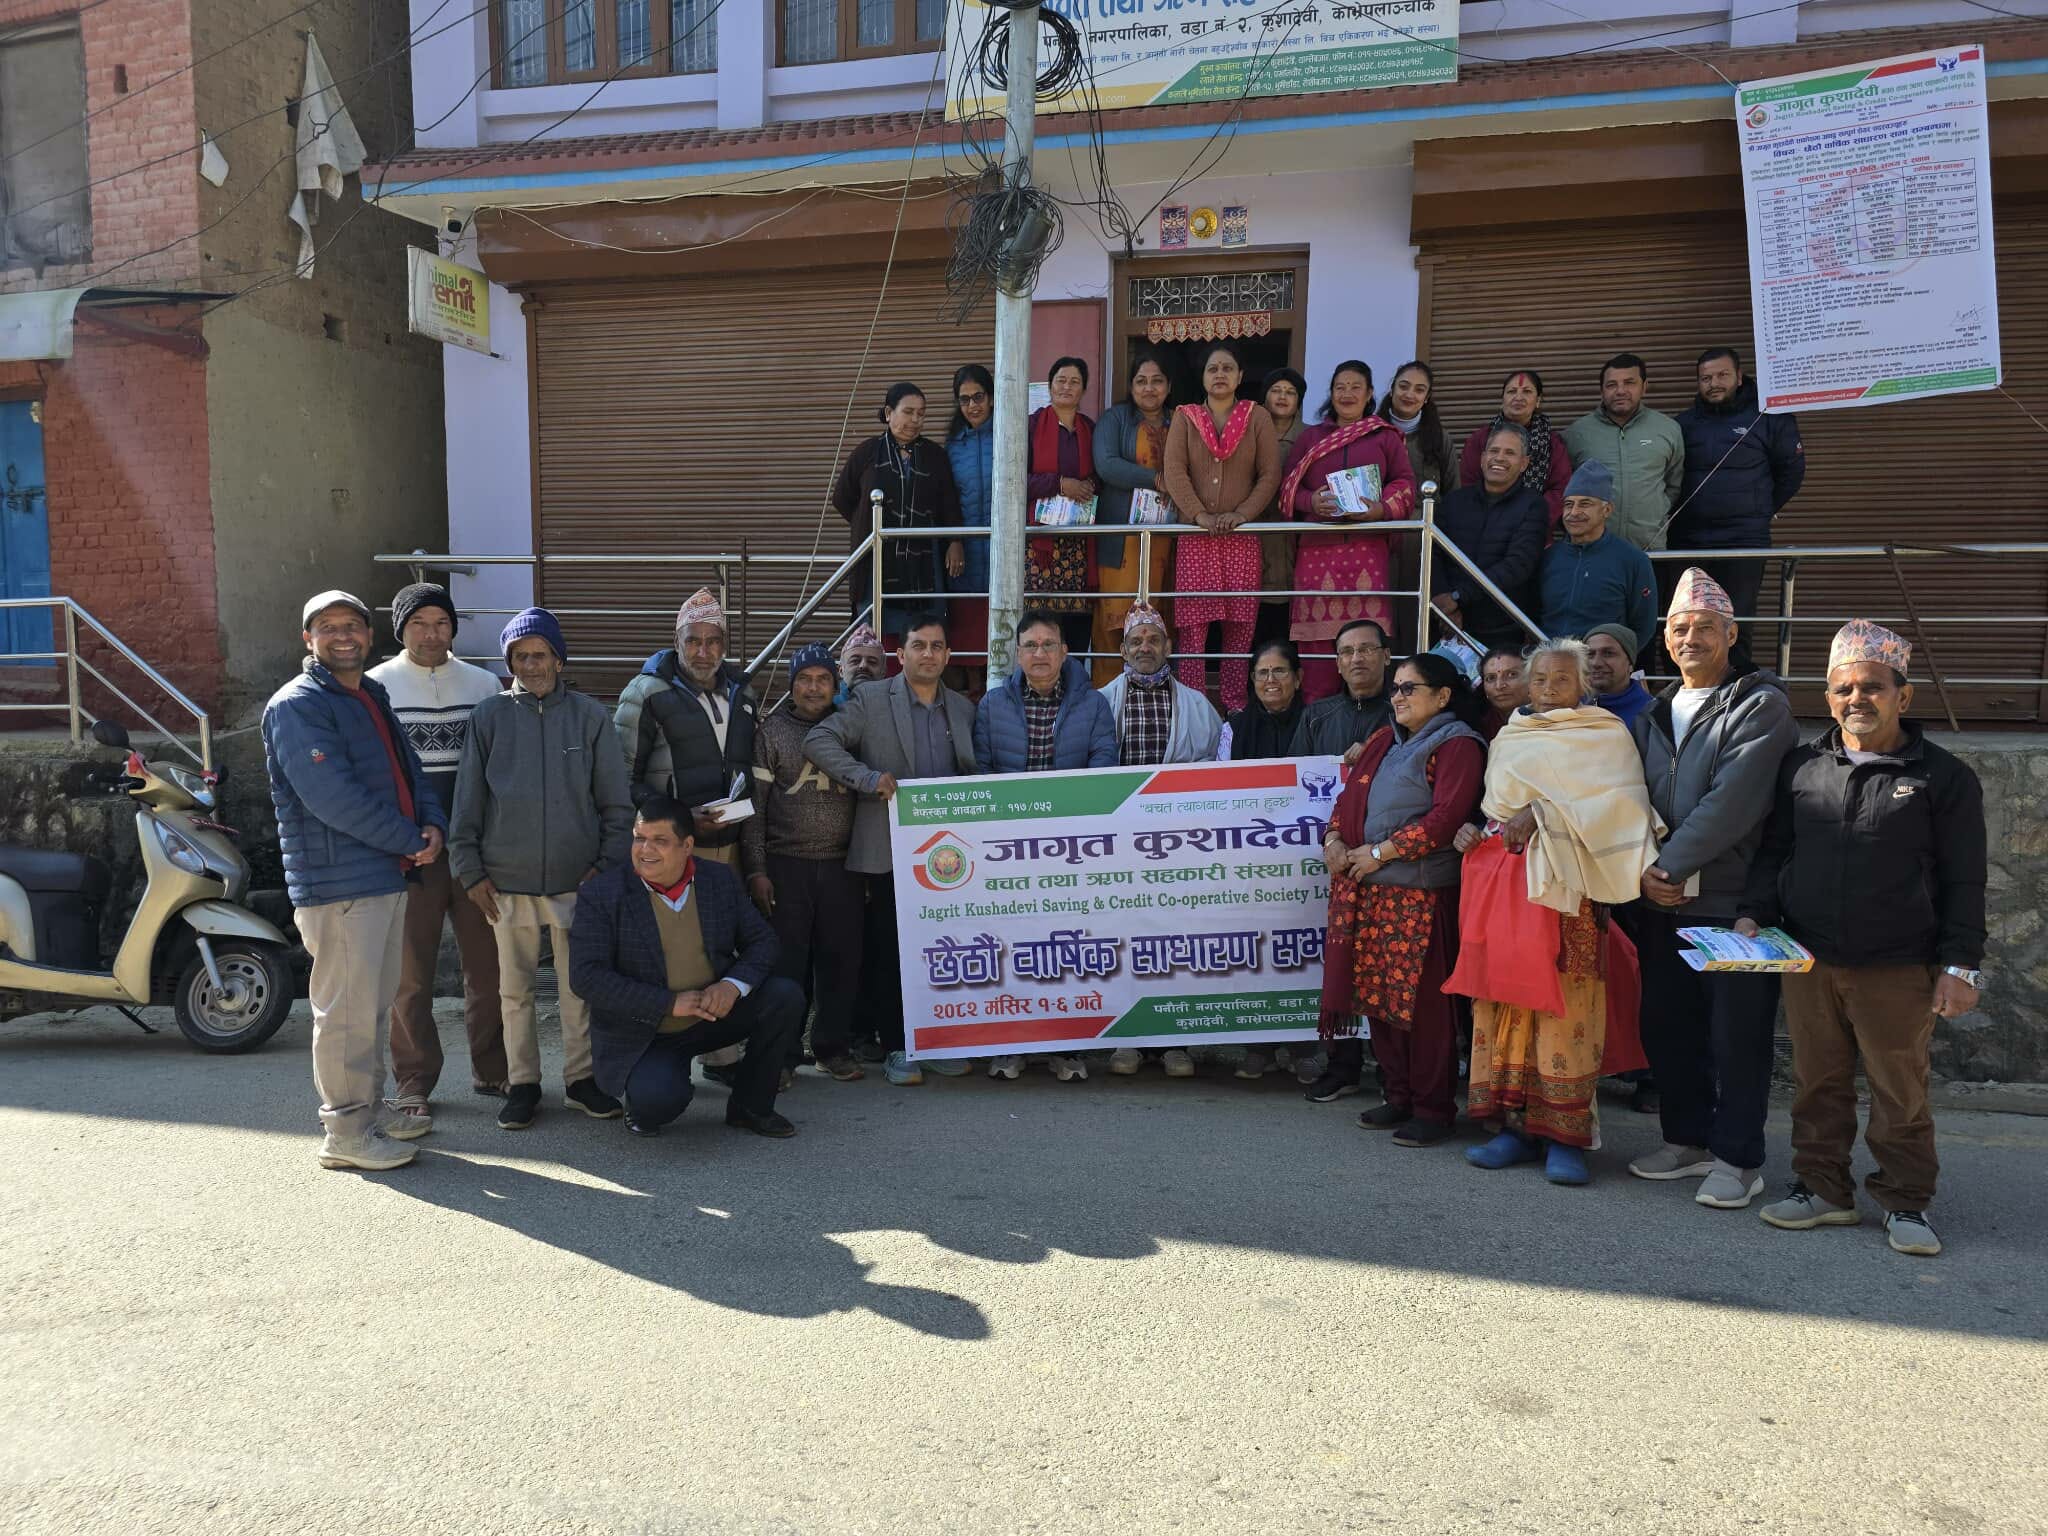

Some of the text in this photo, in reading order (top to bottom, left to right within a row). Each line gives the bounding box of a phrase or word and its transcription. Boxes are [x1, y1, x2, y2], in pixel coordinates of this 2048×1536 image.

[1181, 19, 1208, 36] वडा
[982, 815, 1329, 864] जागृत कुशादेवी
[984, 876, 1031, 891] बचत
[1038, 873, 1078, 889] तथा
[1086, 871, 1134, 887] ऋण
[1141, 862, 1227, 885] सहकारी
[1234, 861, 1294, 882] संस्था
[919, 885, 1329, 922] Jagrit Kushadevi Saving & Credit Co-operative Society Lt
[1012, 928, 1120, 977] वार्षिक
[1130, 930, 1261, 972] साधारण
[933, 1001, 978, 1019] २०८२
[984, 994, 1032, 1016] मंसिर
[1074, 990, 1103, 1011] गते
[1152, 1001, 1190, 1014] पनौती
[1279, 997, 1303, 1008] वडा
[1175, 1015, 1229, 1031] कुशादेवी,
